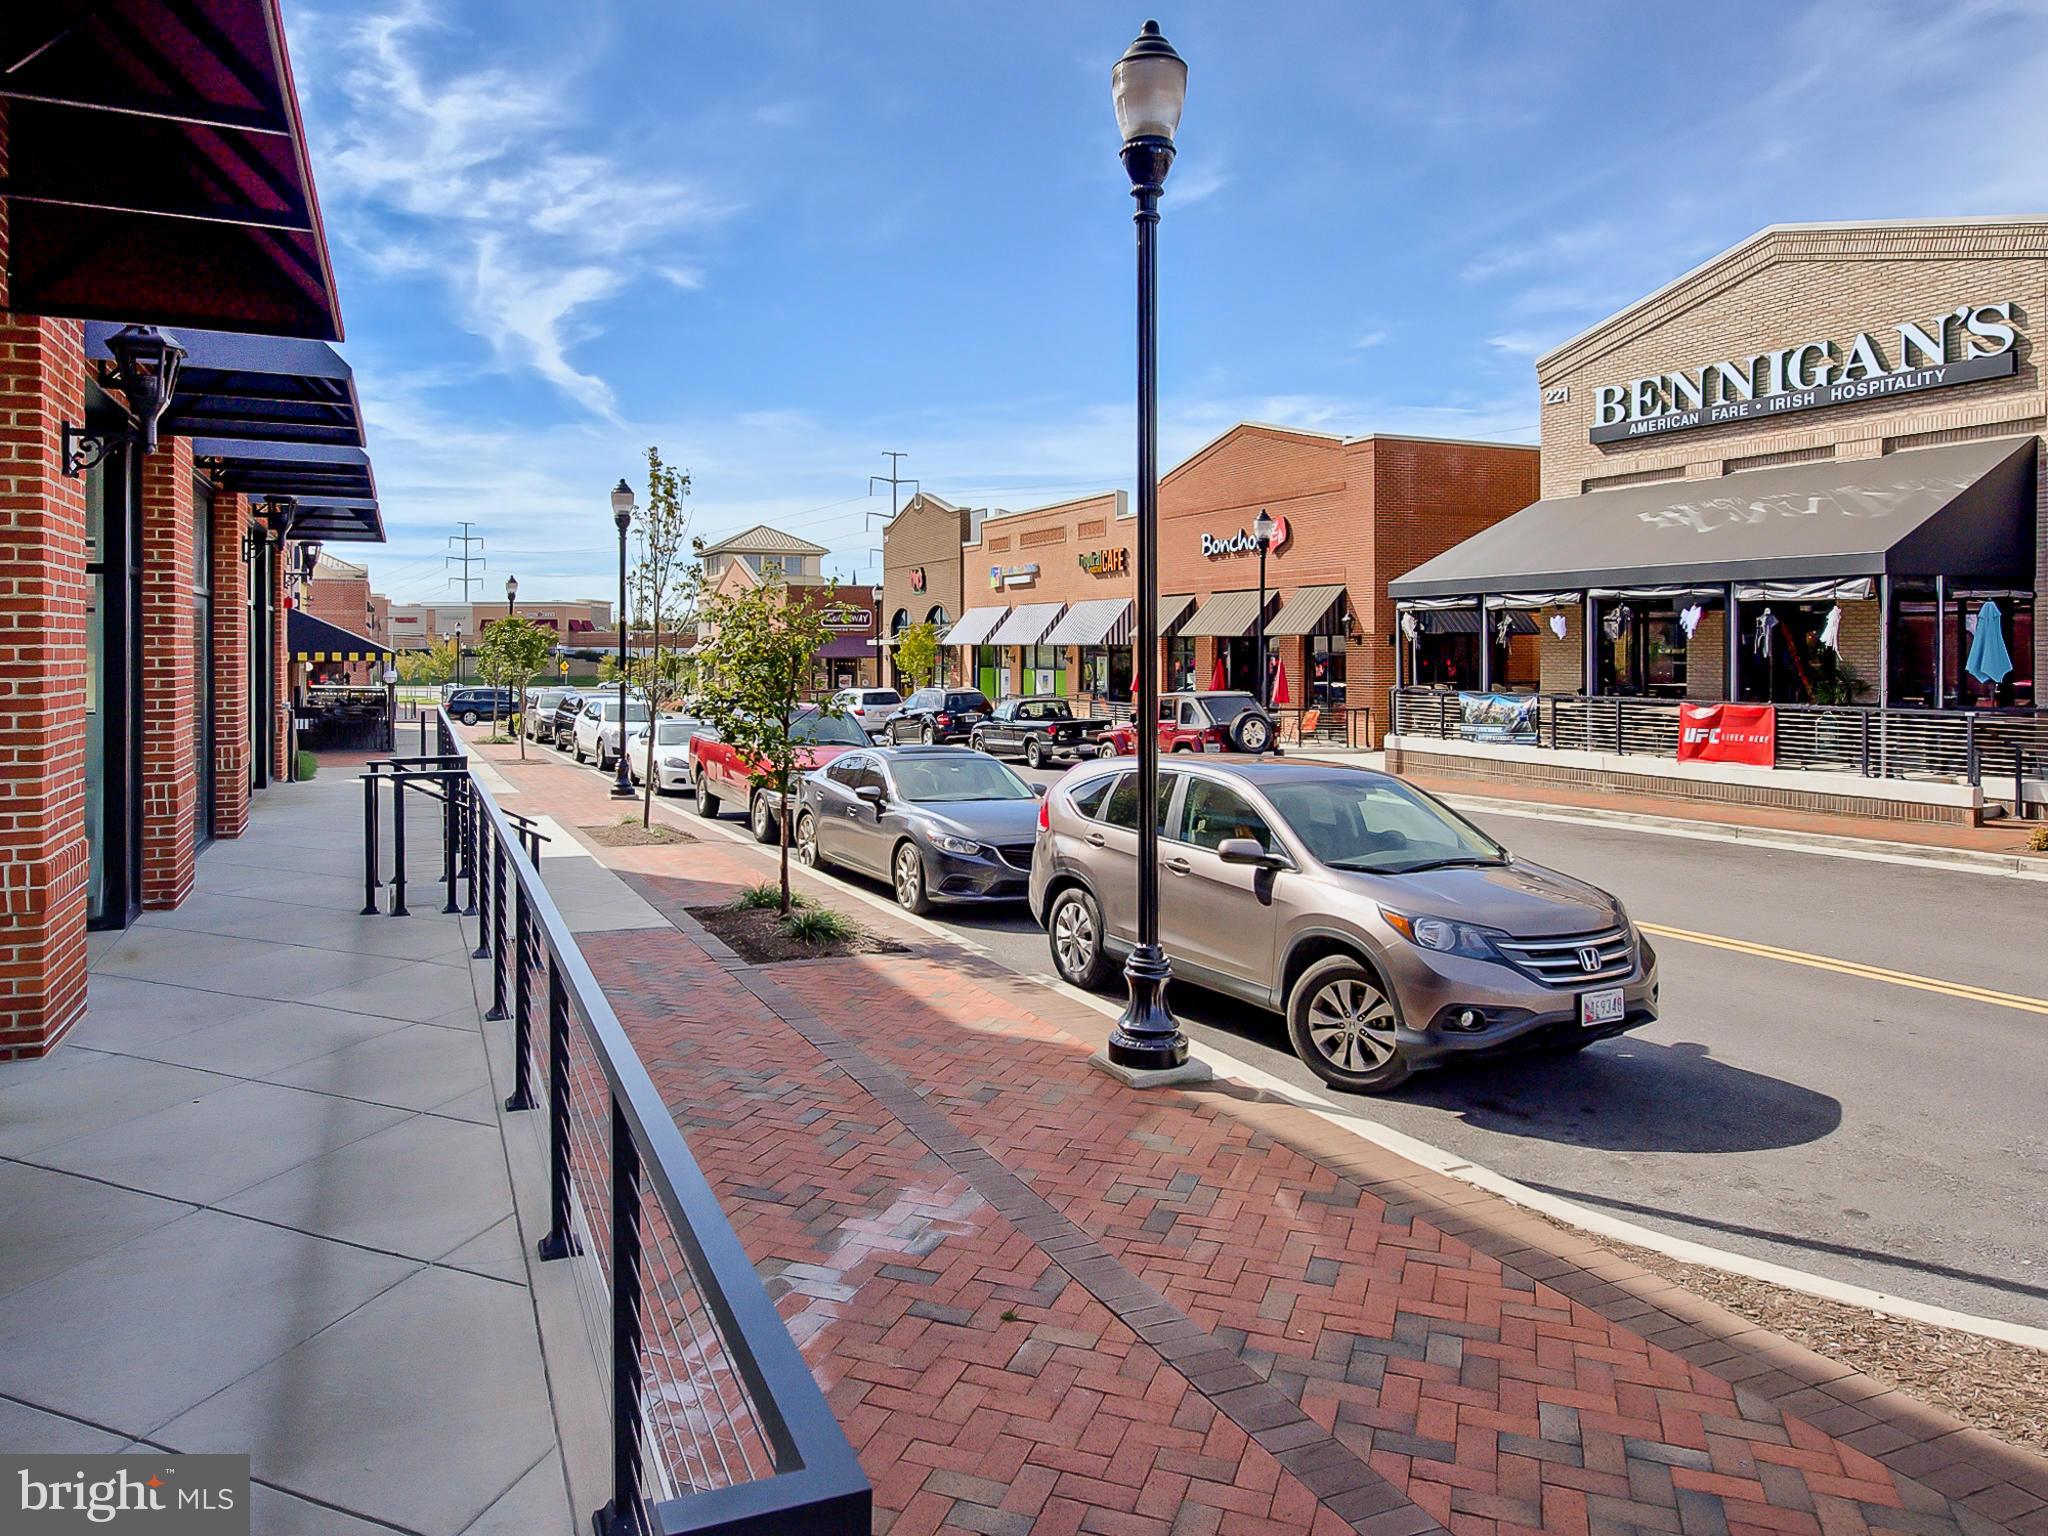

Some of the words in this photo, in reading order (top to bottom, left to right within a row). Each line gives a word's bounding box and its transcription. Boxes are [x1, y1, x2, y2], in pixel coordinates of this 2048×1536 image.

[1590, 302, 2015, 428] BENNIGAN'S
[1544, 386, 1570, 405] 221
[1628, 412, 1699, 435] AMERICAN
[1711, 403, 1749, 421] FARE
[1769, 391, 1815, 412] IRISH
[1830, 368, 1947, 402] HOSPITALITY
[1200, 528, 1262, 557] Boncho
[1101, 548, 1125, 572] CAFE
[1683, 727, 1722, 744] UFC
[1721, 733, 1745, 743] LIVES
[1748, 735, 1769, 744] HERE
